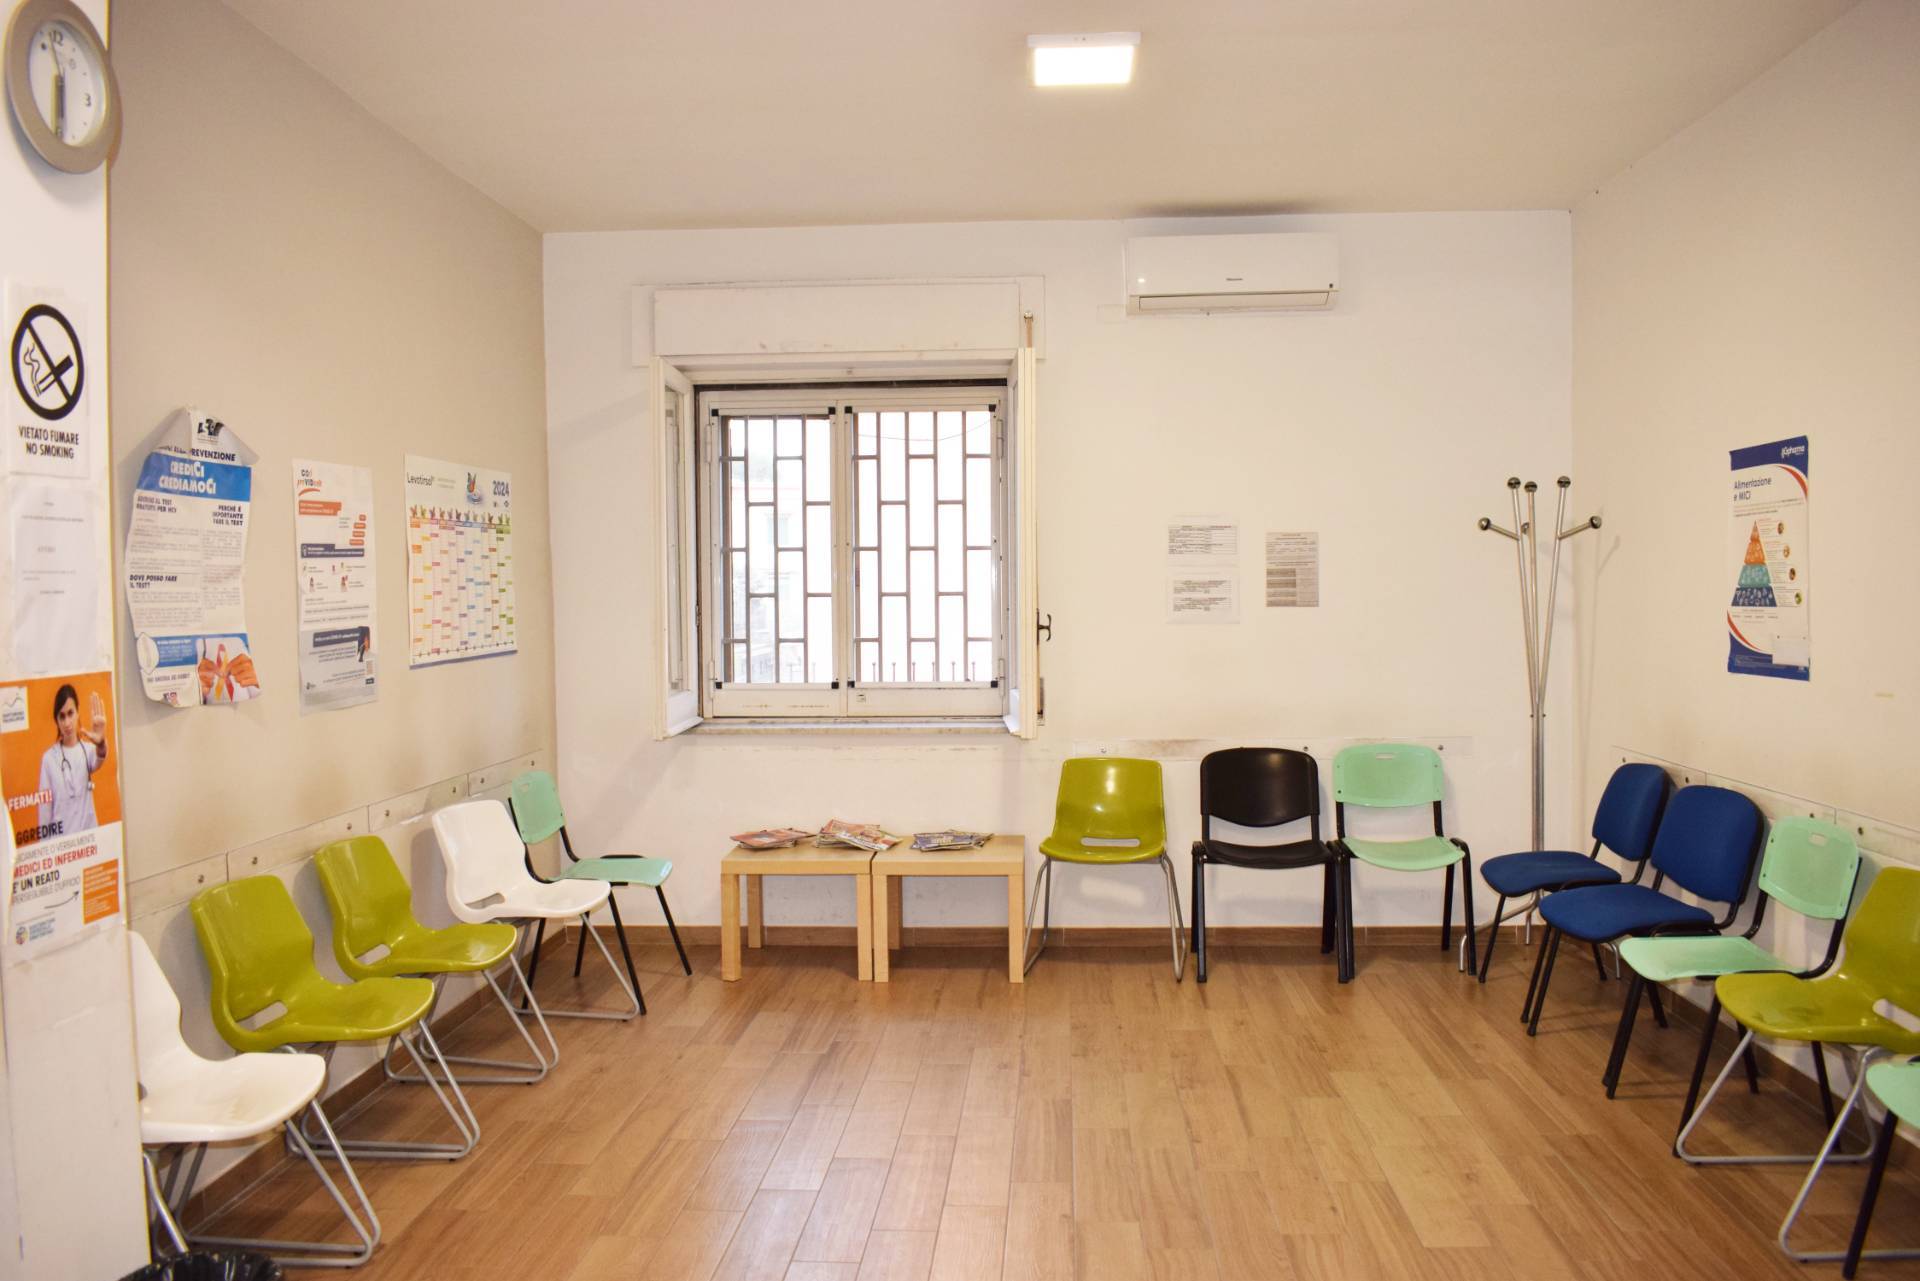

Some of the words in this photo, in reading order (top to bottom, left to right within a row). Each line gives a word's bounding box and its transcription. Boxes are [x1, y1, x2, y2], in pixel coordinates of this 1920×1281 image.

[19, 426, 49, 441] VIETATO
[50, 430, 80, 445] FUMARE
[26, 442, 38, 455] NO
[40, 444, 75, 459] SMOKING
[189, 447, 236, 462] REVENZIONE
[492, 480, 510, 497] 2024
[1734, 477, 1772, 489] Alimentazione
[8, 789, 53, 811] FERMATI!
[14, 861, 41, 879] MEDICI
[42, 857, 53, 870] ED
[55, 844, 98, 866] INFERMIERI
[20, 877, 34, 892] UN
[35, 869, 60, 888] REATO
